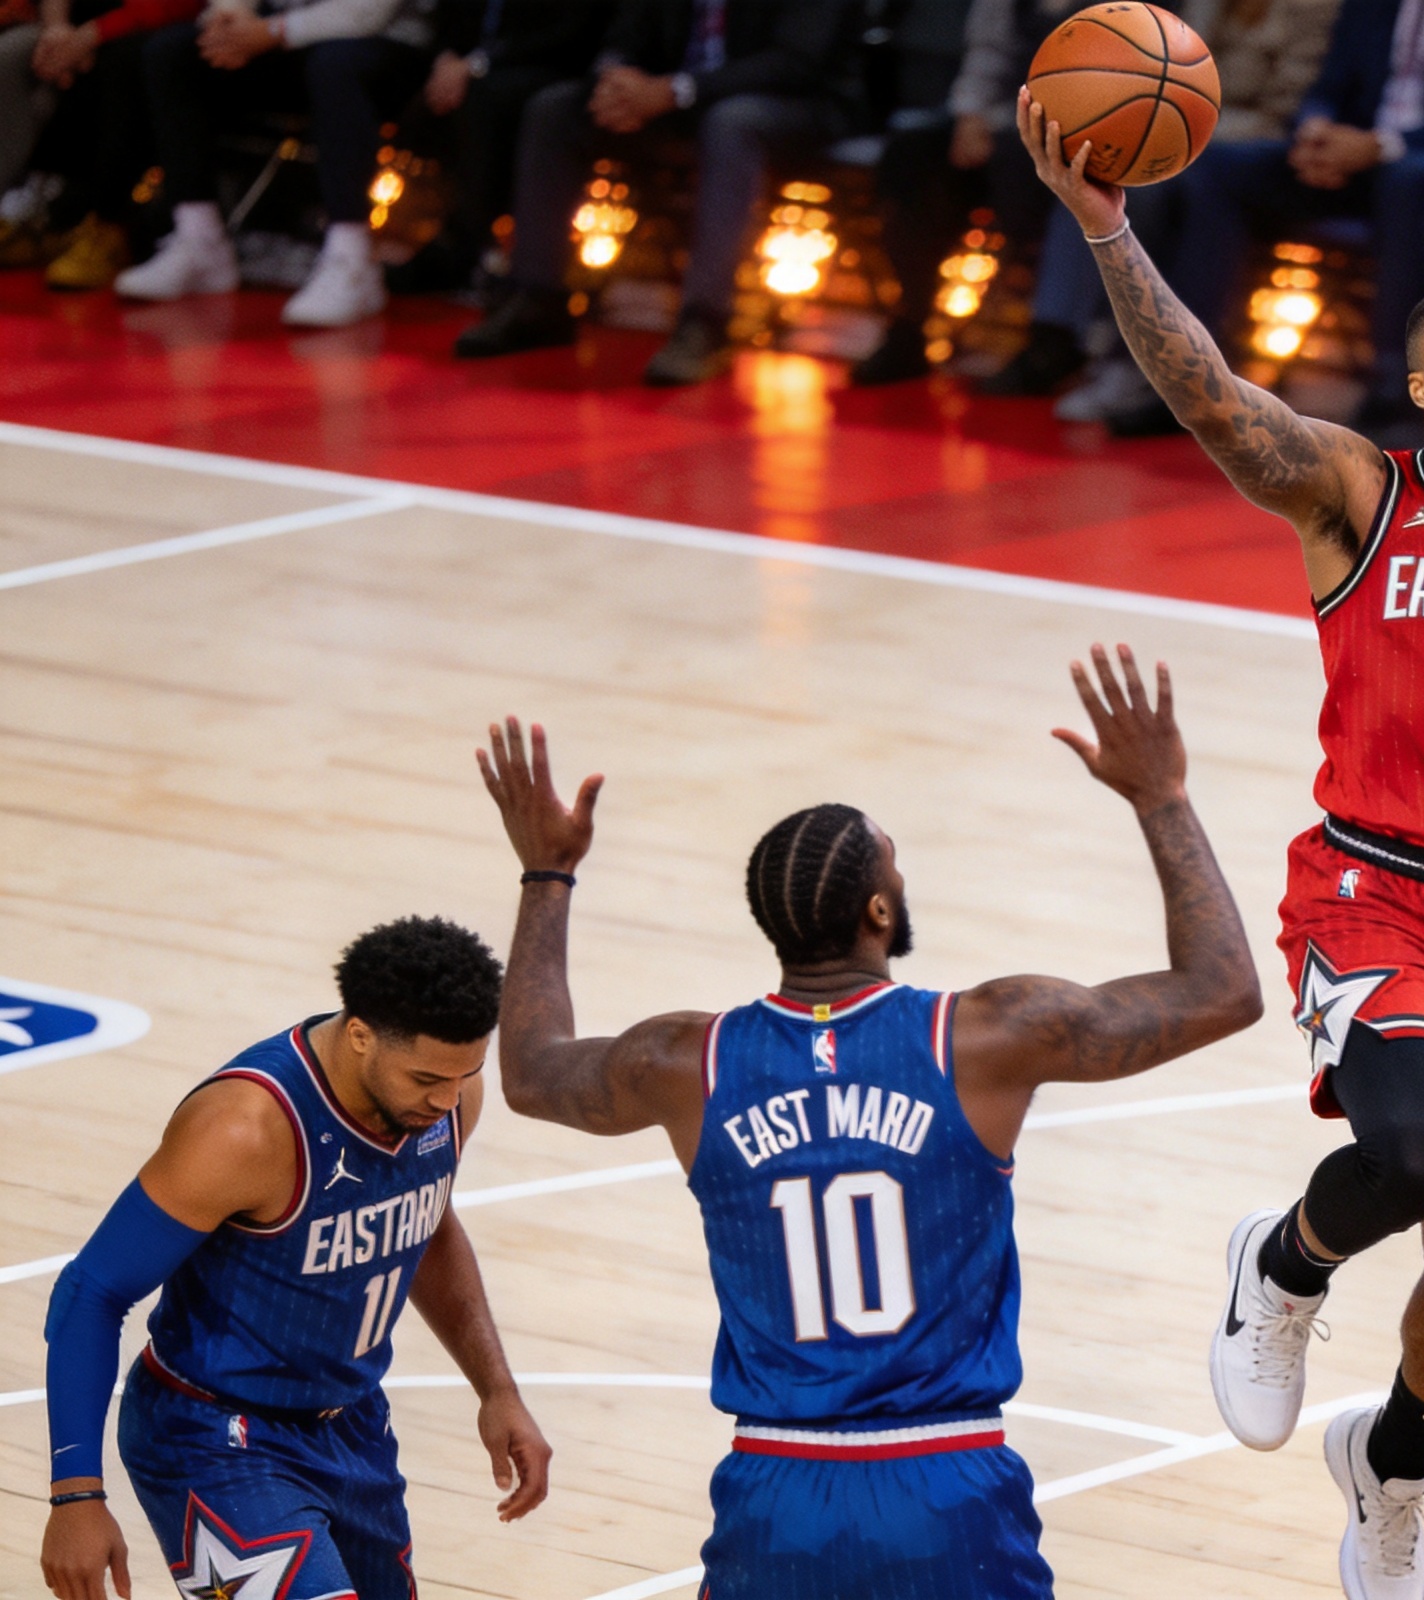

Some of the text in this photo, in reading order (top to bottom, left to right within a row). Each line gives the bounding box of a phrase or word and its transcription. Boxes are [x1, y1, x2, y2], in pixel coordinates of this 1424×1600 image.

[723, 1083, 935, 1168] EAST MARD
[770, 1170, 917, 1342] 10
[353, 1265, 403, 1359] 11
